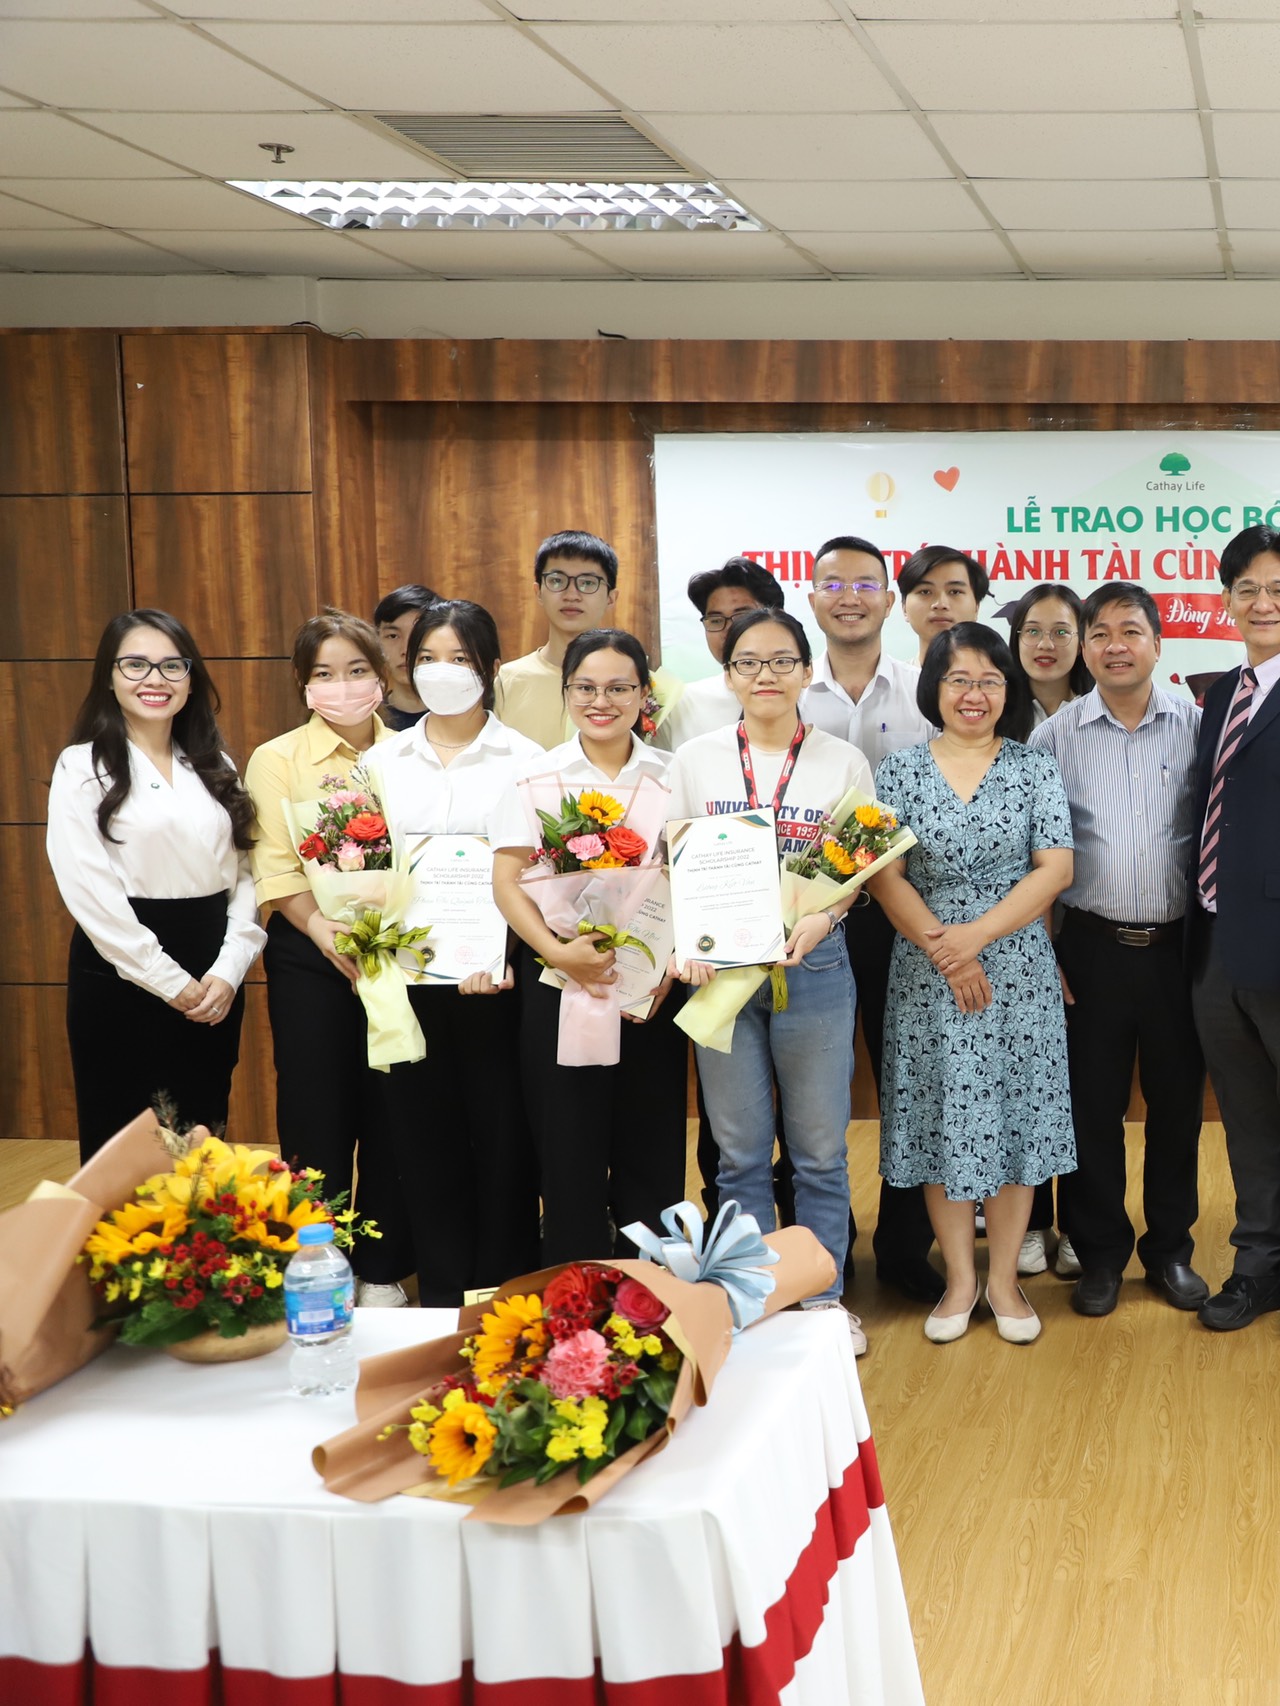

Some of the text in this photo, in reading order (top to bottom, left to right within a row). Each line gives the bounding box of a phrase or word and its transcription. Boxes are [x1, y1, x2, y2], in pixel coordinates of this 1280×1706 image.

[1146, 481, 1206, 493] Cathay Life
[1006, 496, 1041, 533] LỄ
[1051, 505, 1144, 533] TRAO
[1155, 505, 1232, 540] HỌC
[1080, 542, 1142, 580] TÀI
[1153, 542, 1220, 580] CÙN
[1165, 597, 1212, 634] Đồng
